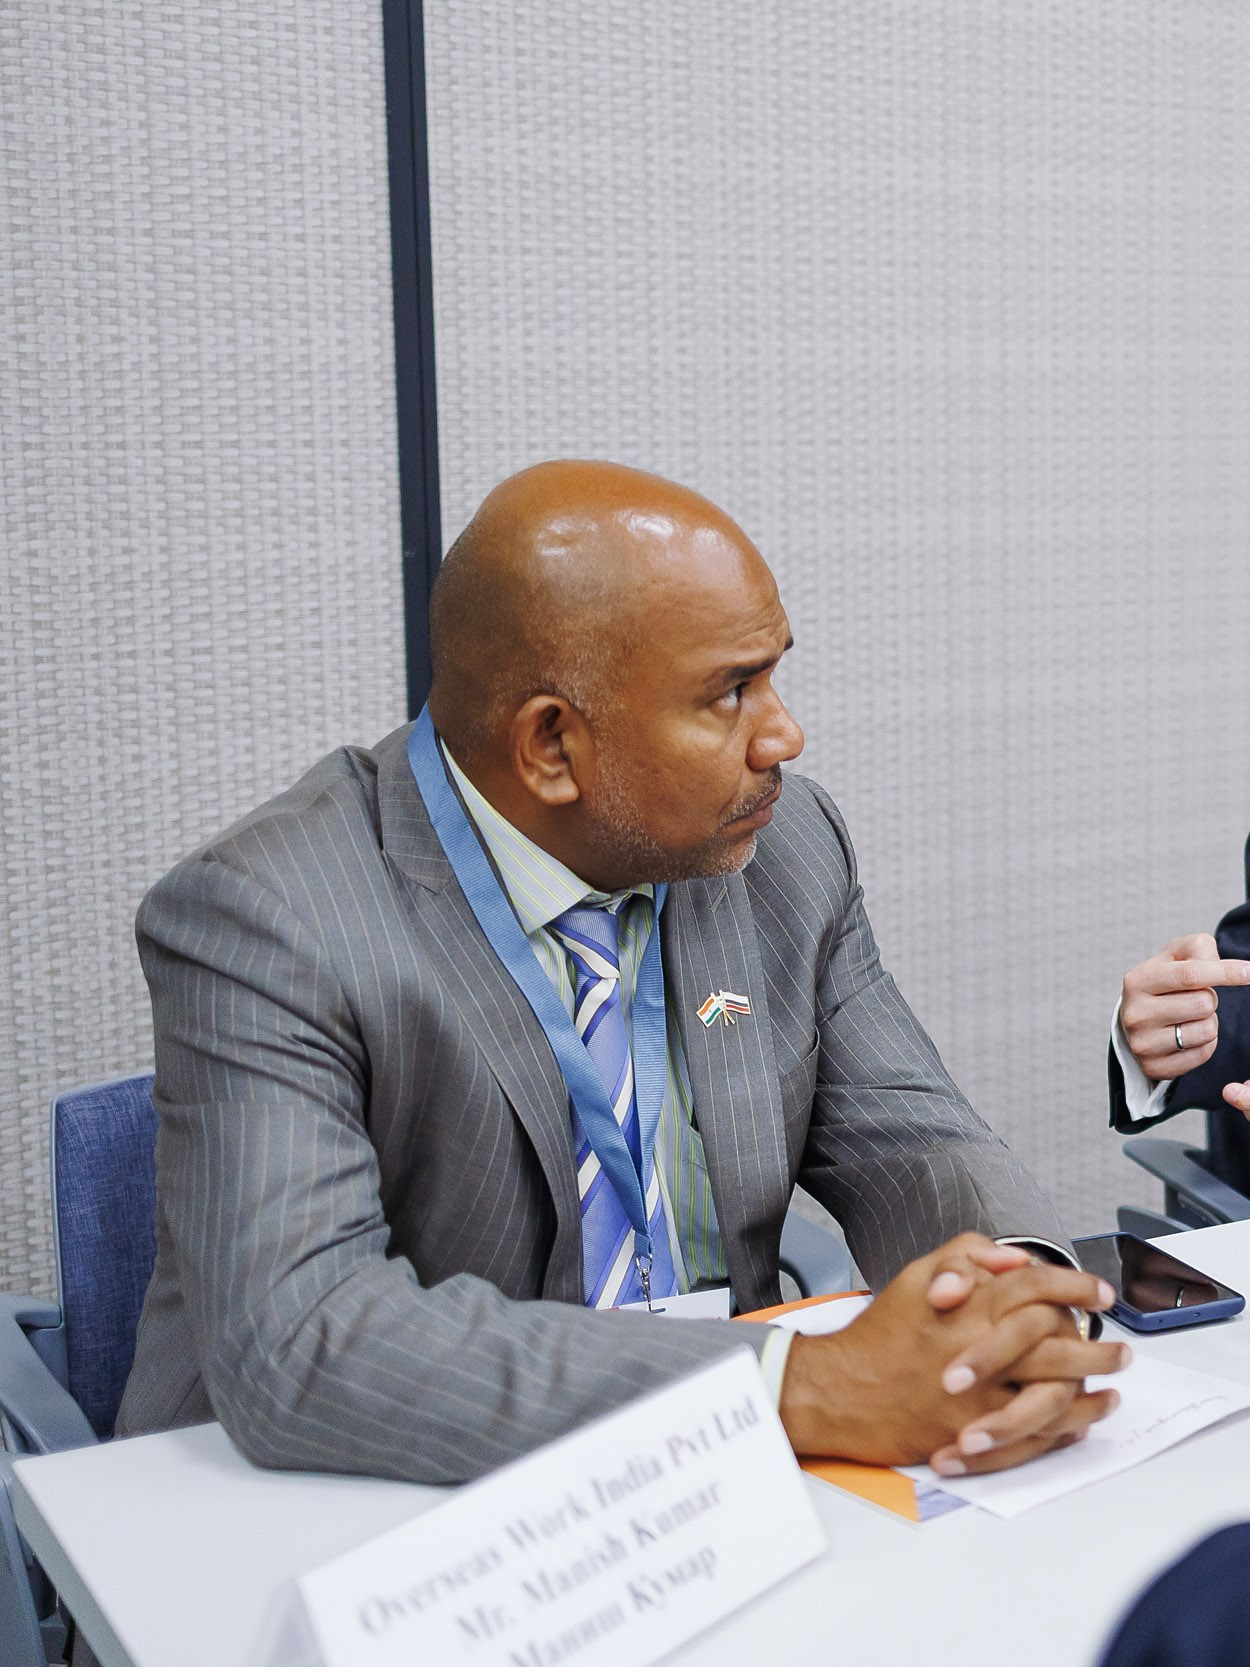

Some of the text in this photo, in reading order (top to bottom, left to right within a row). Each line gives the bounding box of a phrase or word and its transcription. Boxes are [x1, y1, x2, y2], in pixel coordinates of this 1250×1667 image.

[359, 1395, 761, 1636] Overseas Work India Pvt Ltd
[454, 1481, 723, 1640] Mr. Manish Kumar
[625, 1545, 719, 1611] Кумар
